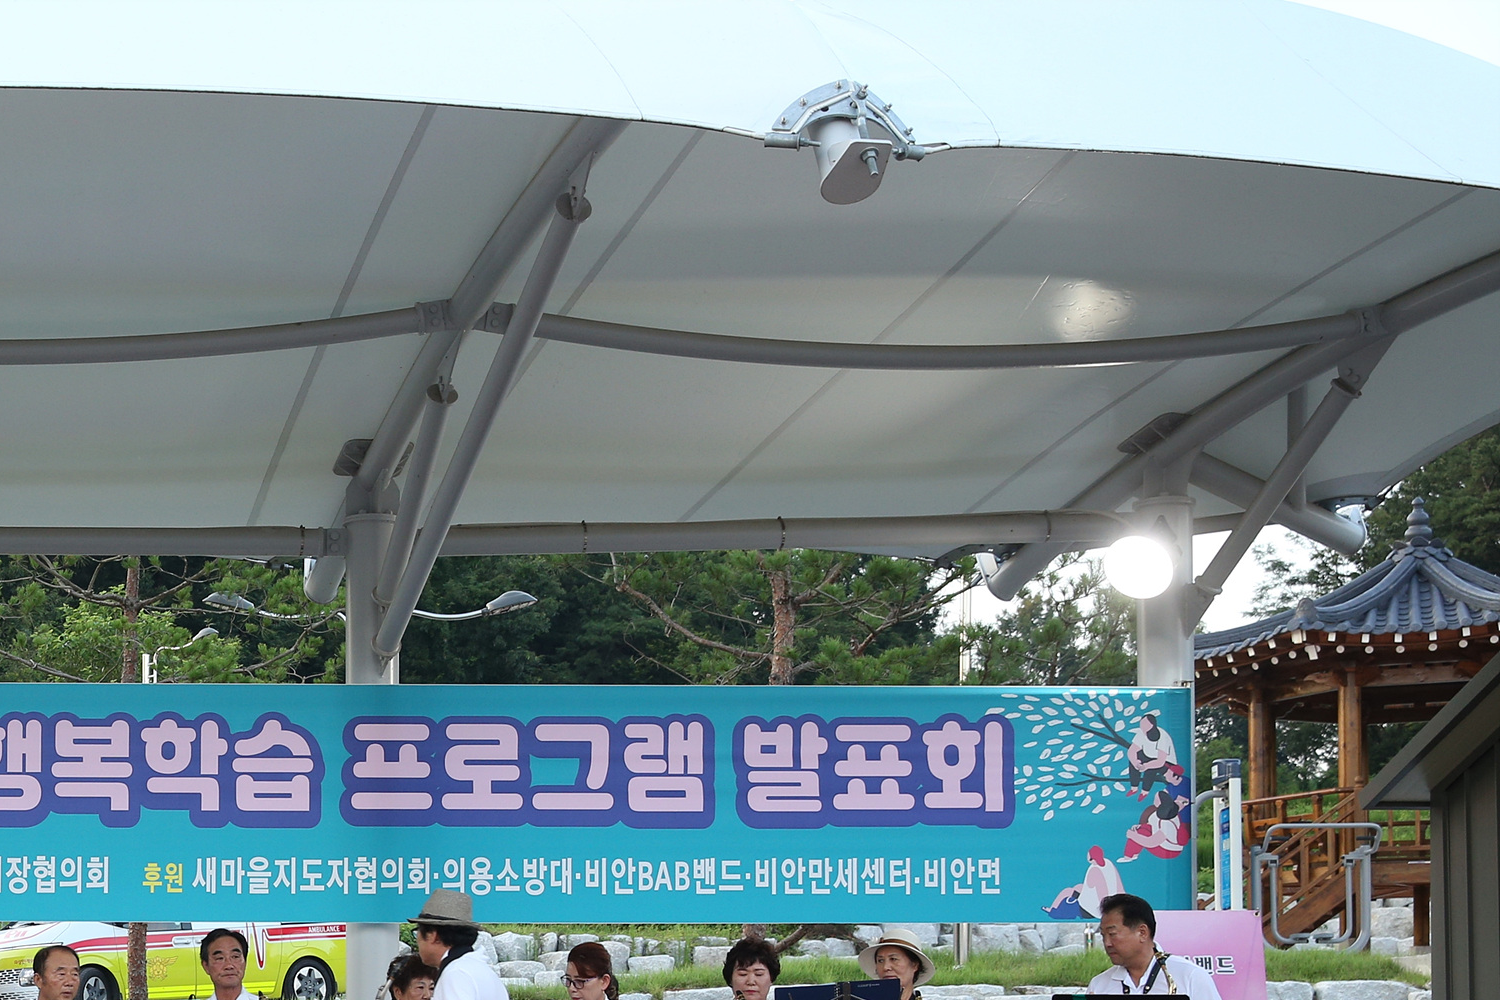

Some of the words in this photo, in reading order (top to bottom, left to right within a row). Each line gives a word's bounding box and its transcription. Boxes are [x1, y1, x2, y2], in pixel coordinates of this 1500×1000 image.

[349, 720, 705, 813] 프로그램
[742, 720, 1005, 813] 발표회
[141, 861, 184, 894] 후원
[308, 925, 341, 933] AMBULANCE
